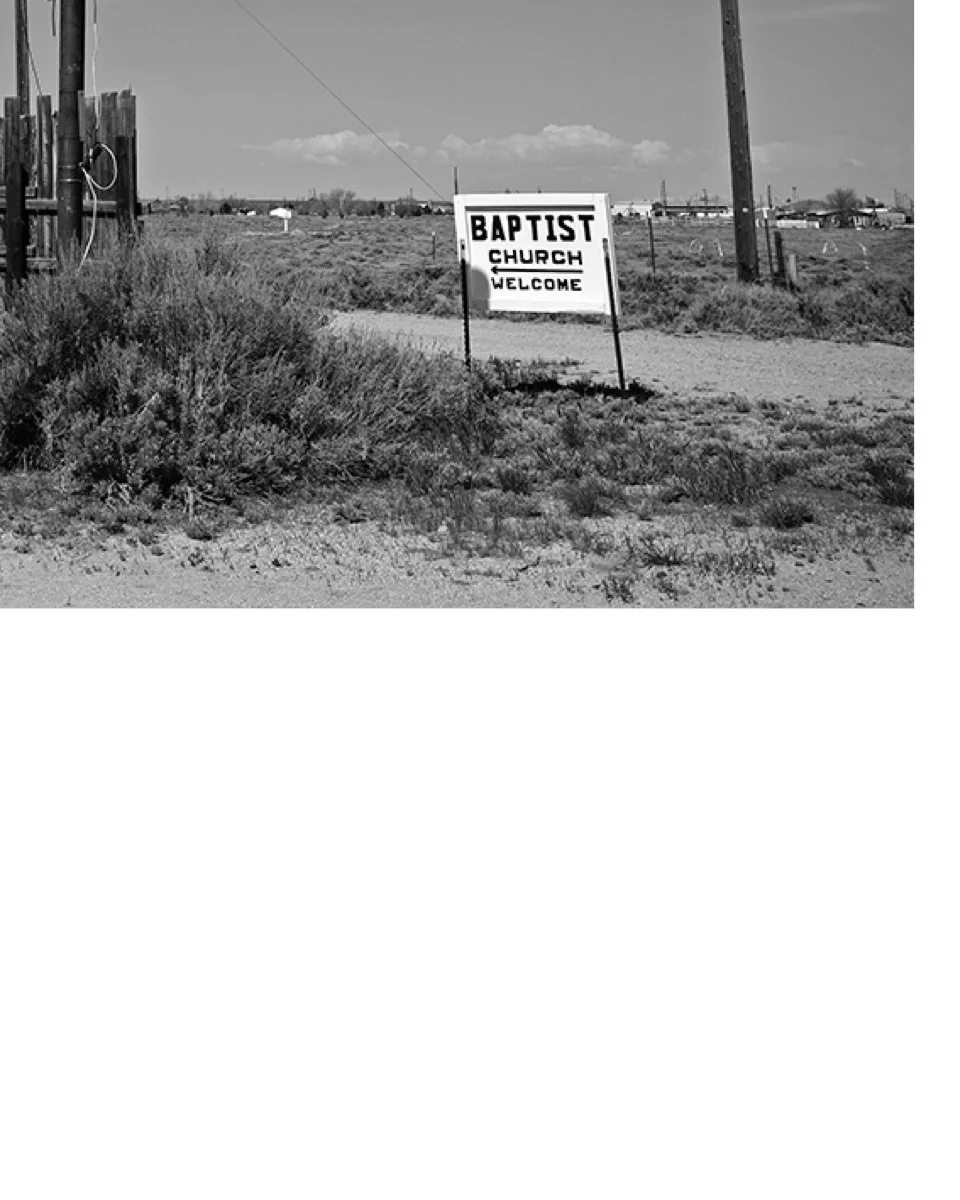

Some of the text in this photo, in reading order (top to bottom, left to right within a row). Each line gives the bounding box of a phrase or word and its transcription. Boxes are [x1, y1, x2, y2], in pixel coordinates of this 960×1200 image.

[470, 214, 595, 242] BAPTIST
[488, 249, 583, 265] CHURCH
[491, 277, 582, 291] WELCOME
